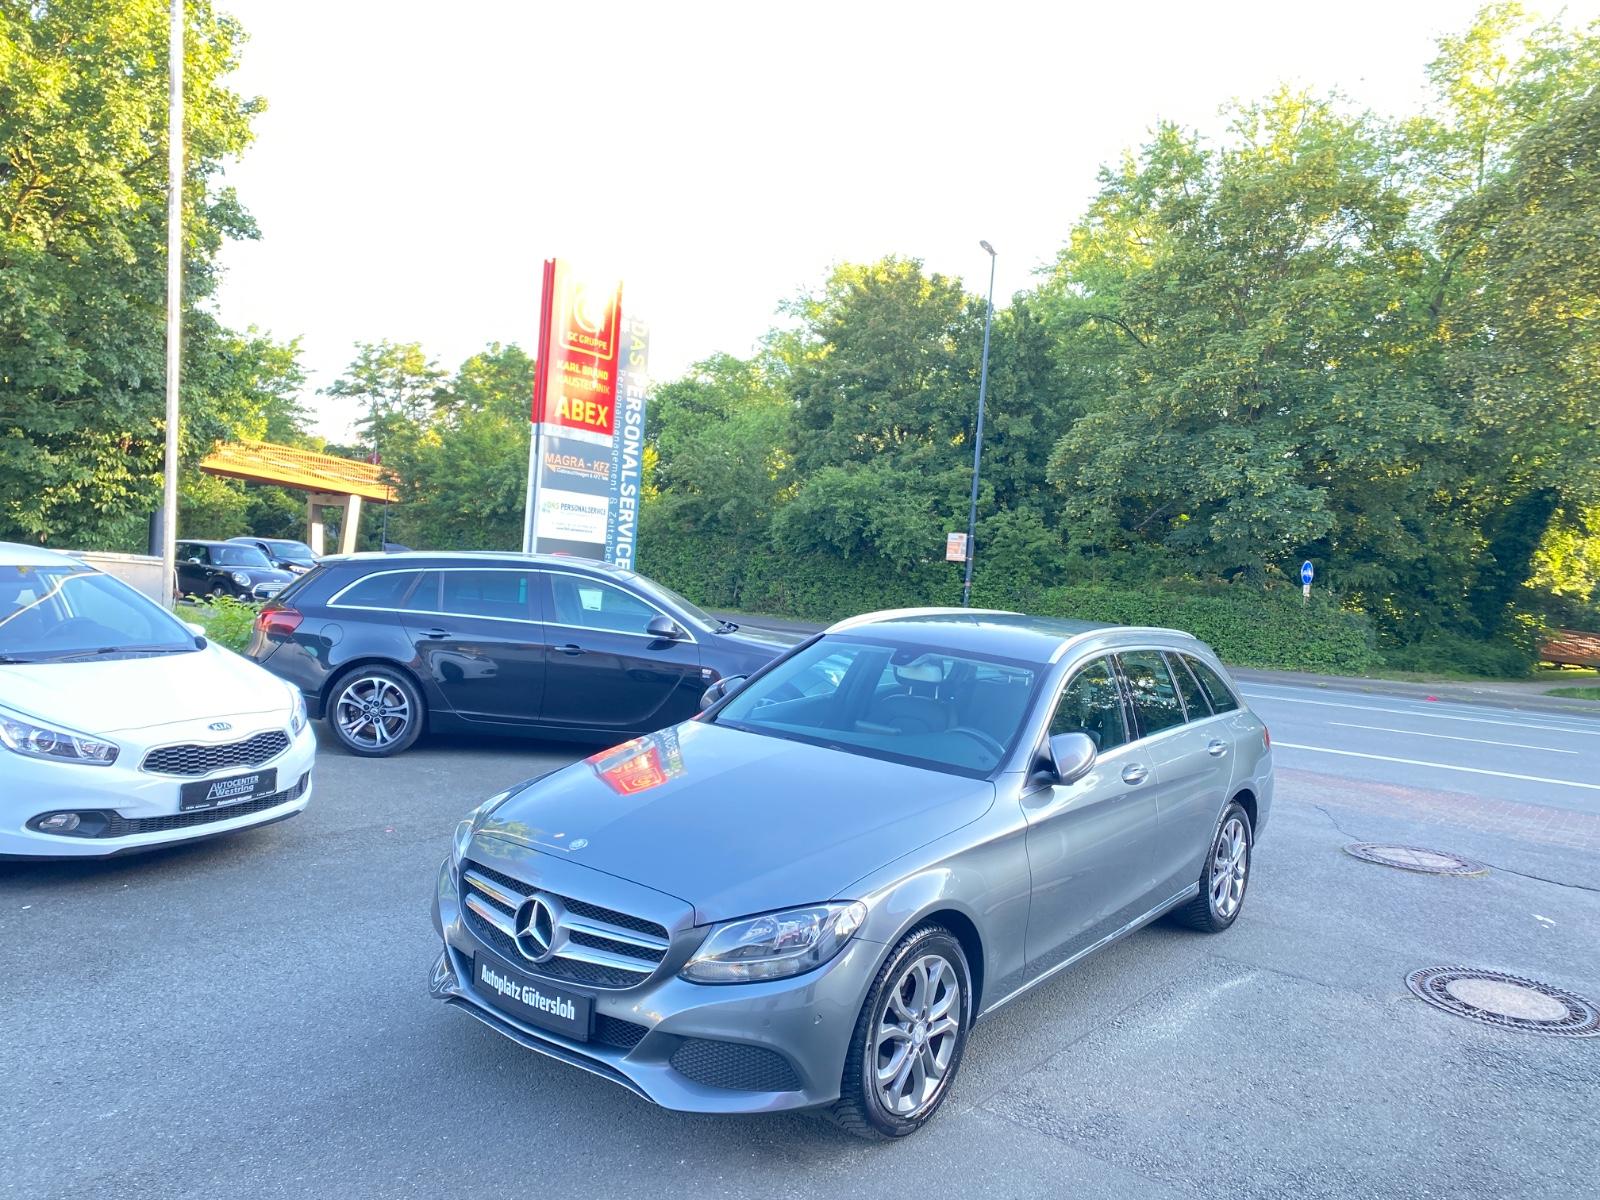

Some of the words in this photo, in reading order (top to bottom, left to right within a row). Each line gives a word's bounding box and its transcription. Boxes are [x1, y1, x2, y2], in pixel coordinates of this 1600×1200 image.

[579, 335, 608, 351] GRUPPE
[556, 360, 581, 375] KARL
[554, 394, 609, 428] ABEX
[544, 452, 585, 469] MAGRA
[593, 460, 610, 473] KFZ
[560, 502, 607, 516] PERSONALSERVICE
[213, 722, 231, 731] KIA
[206, 775, 259, 800] AUTOCENTER
[216, 784, 255, 797] Westring
[481, 964, 521, 1000] Autoplatz
[521, 985, 575, 1020] Gütersloh
